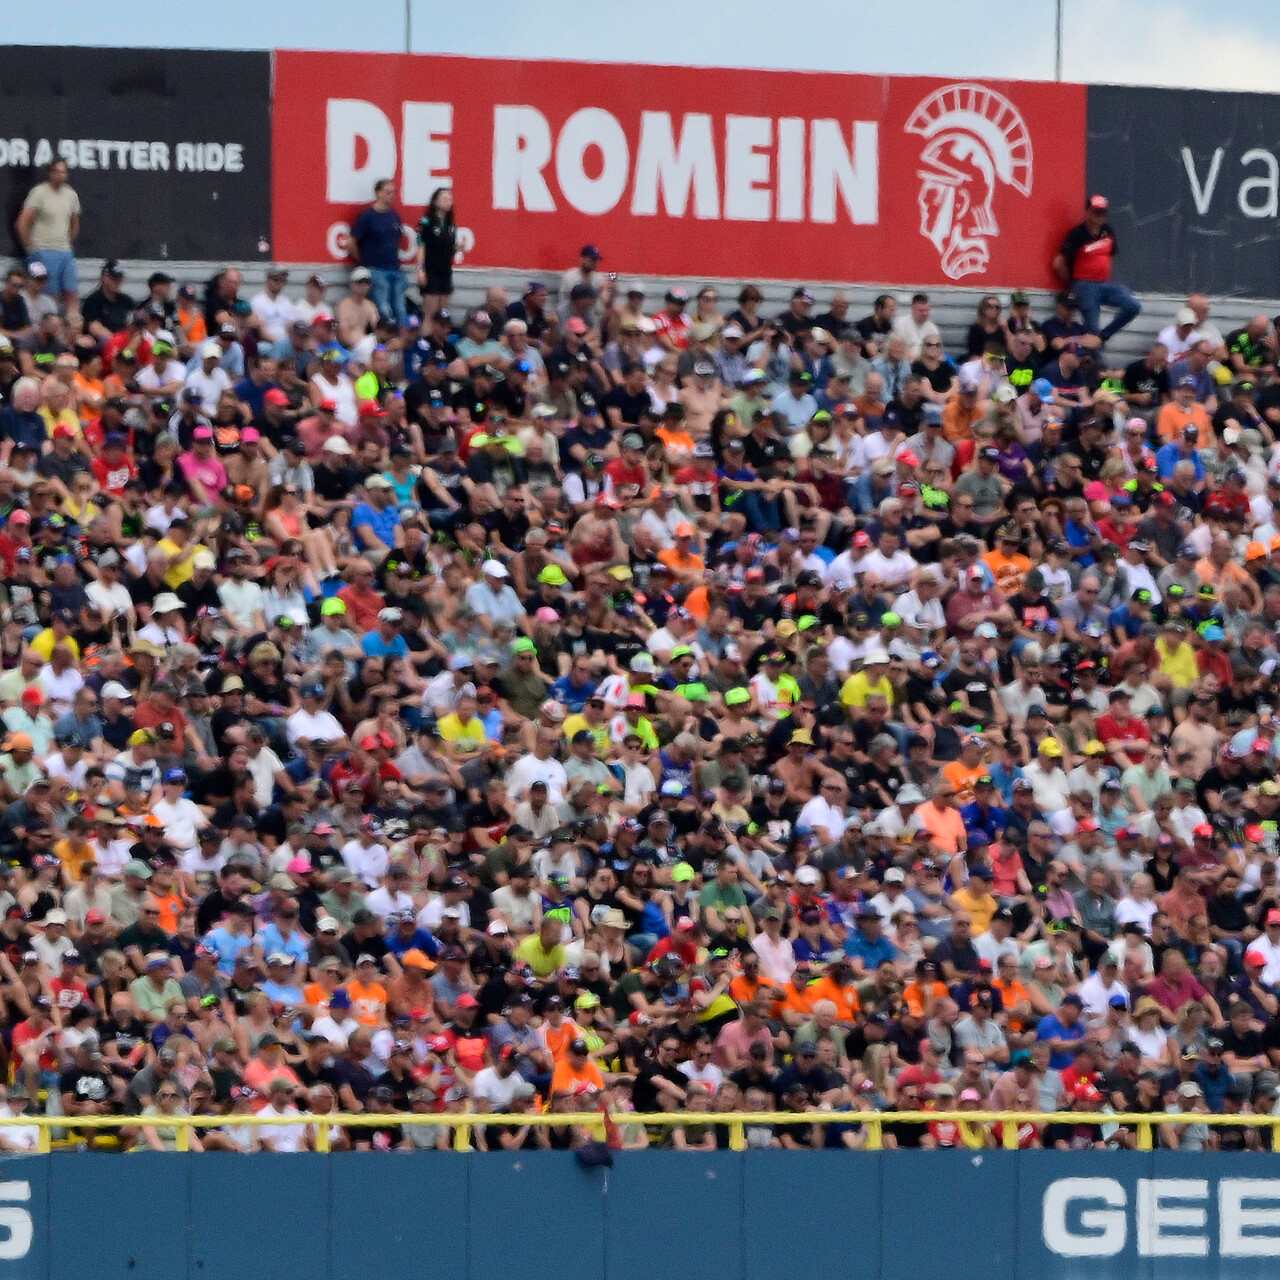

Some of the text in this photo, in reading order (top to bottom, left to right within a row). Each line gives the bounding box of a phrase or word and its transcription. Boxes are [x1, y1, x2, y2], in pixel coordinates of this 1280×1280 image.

[34, 139, 54, 167] A
[57, 139, 170, 171] BETTER
[174, 142, 244, 173] RIDE
[325, 97, 879, 226] DE ROMEIN
